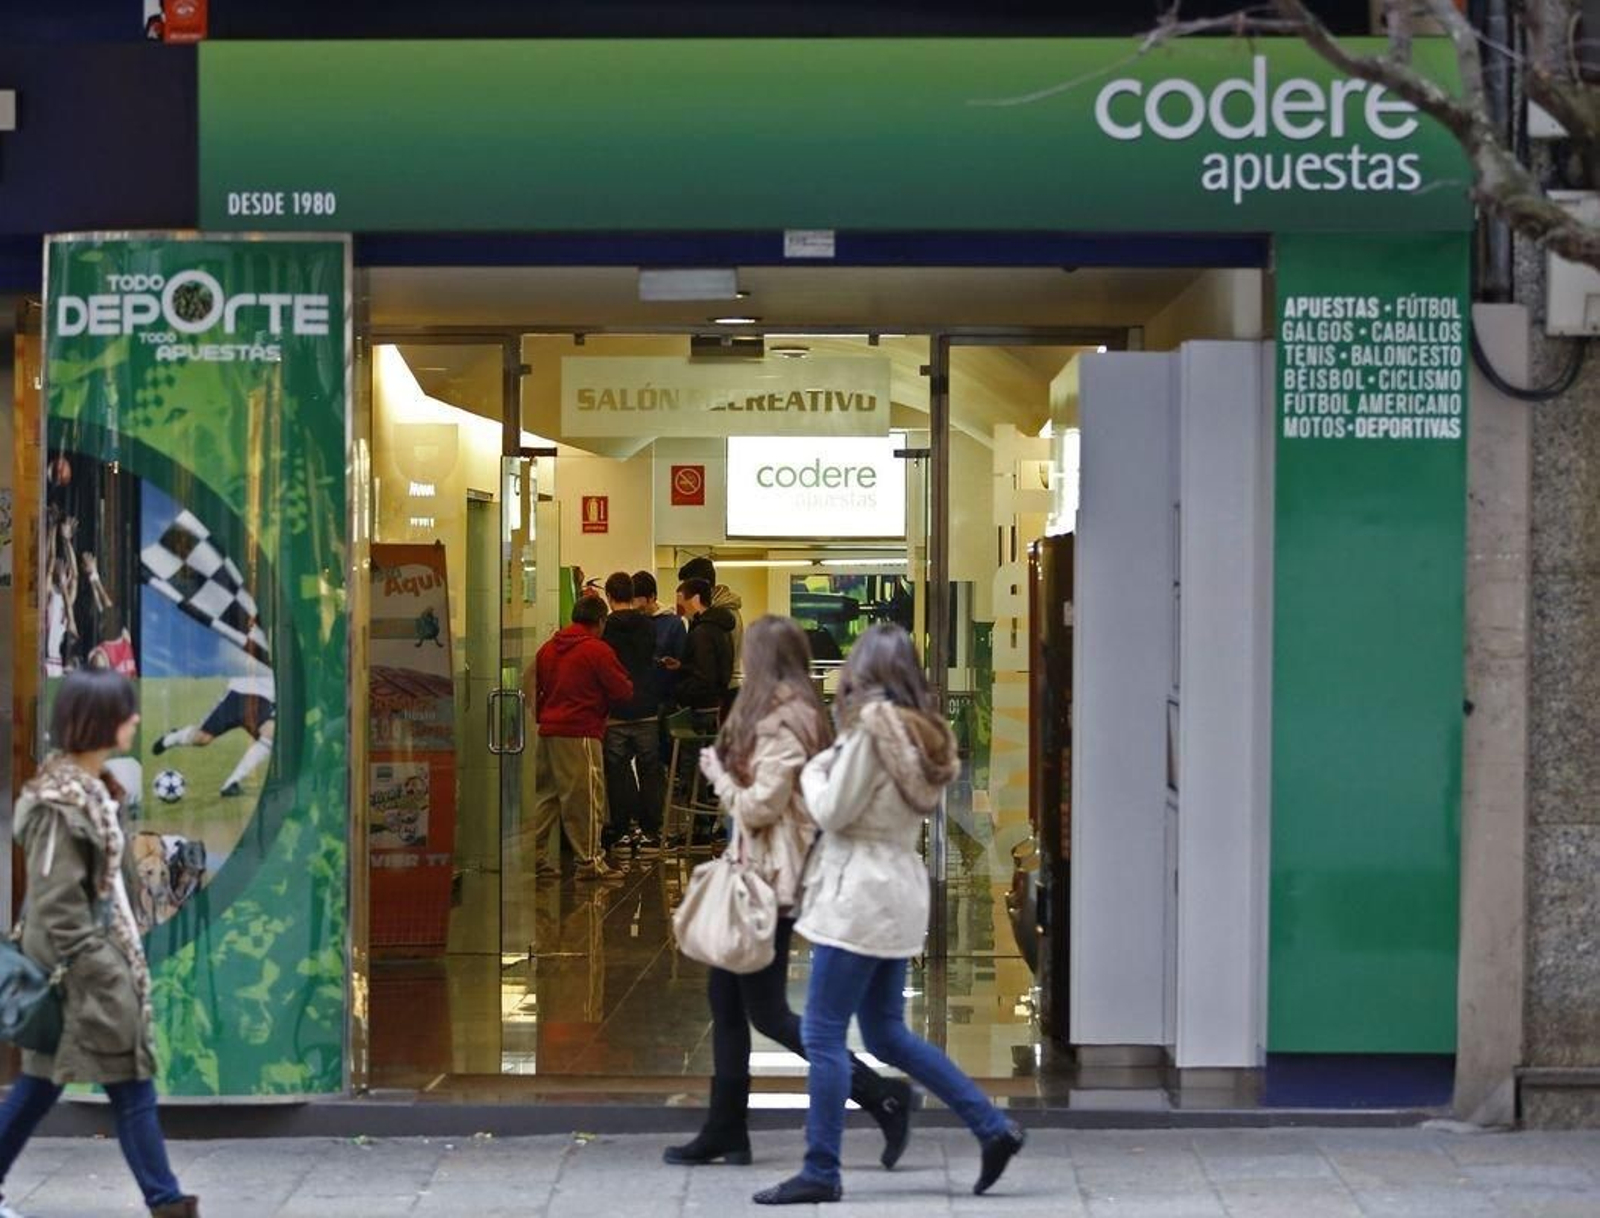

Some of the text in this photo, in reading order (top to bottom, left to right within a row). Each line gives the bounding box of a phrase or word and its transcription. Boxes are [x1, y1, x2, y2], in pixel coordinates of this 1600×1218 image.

[1094, 55, 1419, 140] codere
[1201, 144, 1422, 205] apuestas
[227, 192, 336, 215] DESDE 1980
[106, 274, 165, 292] TODO
[1283, 293, 1462, 318] APUESTAS FÚTBOL
[138, 332, 177, 344] TODO
[1282, 320, 1462, 343] GALGOS CABALLOS
[156, 344, 282, 362] APUESTAS
[1284, 344, 1462, 366] TENIS BALONCESTO
[1378, 369, 1462, 390] CICLISMO
[577, 382, 680, 412] SALÓN
[1357, 393, 1462, 415] AMERICANO
[757, 458, 877, 488] codere
